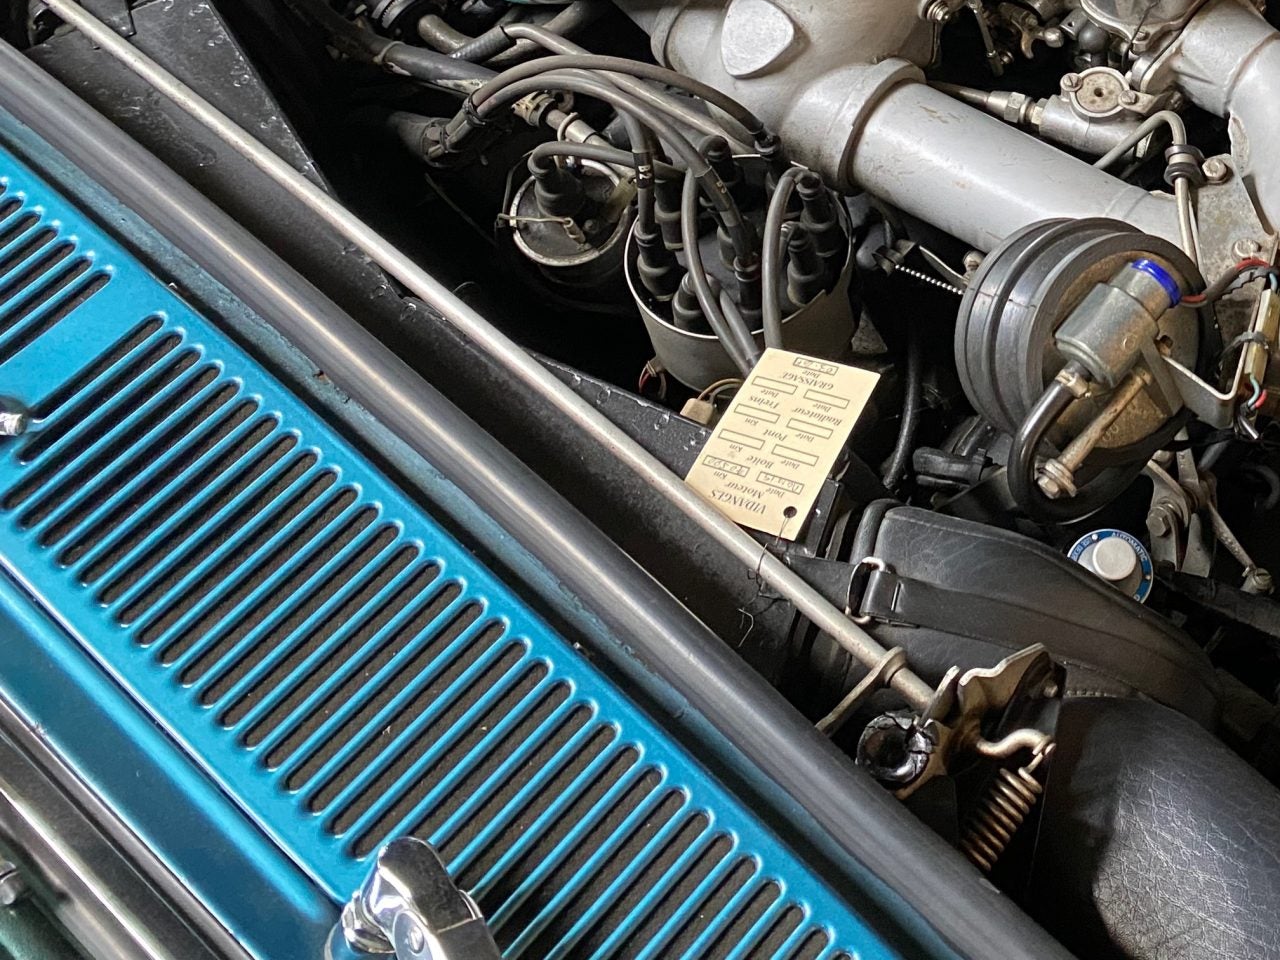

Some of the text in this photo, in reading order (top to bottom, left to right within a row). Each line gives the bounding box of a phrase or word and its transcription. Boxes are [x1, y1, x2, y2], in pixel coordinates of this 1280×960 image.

[637, 163, 652, 180] B2
[801, 368, 820, 379] Date
[780, 368, 834, 393] GRAISSAGE
[759, 387, 778, 398] Date
[747, 393, 779, 410] Freins
[811, 401, 831, 413] Date
[744, 416, 758, 427] Km
[790, 404, 842, 427] Radiateur
[761, 427, 787, 442] Pont
[793, 431, 814, 443] Date
[728, 442, 743, 453] Km
[779, 458, 800, 470] Date
[712, 470, 727, 480] Km
[723, 479, 764, 499] Moteur
[764, 486, 785, 498] Date
[708, 488, 767, 515] VIDANGES
